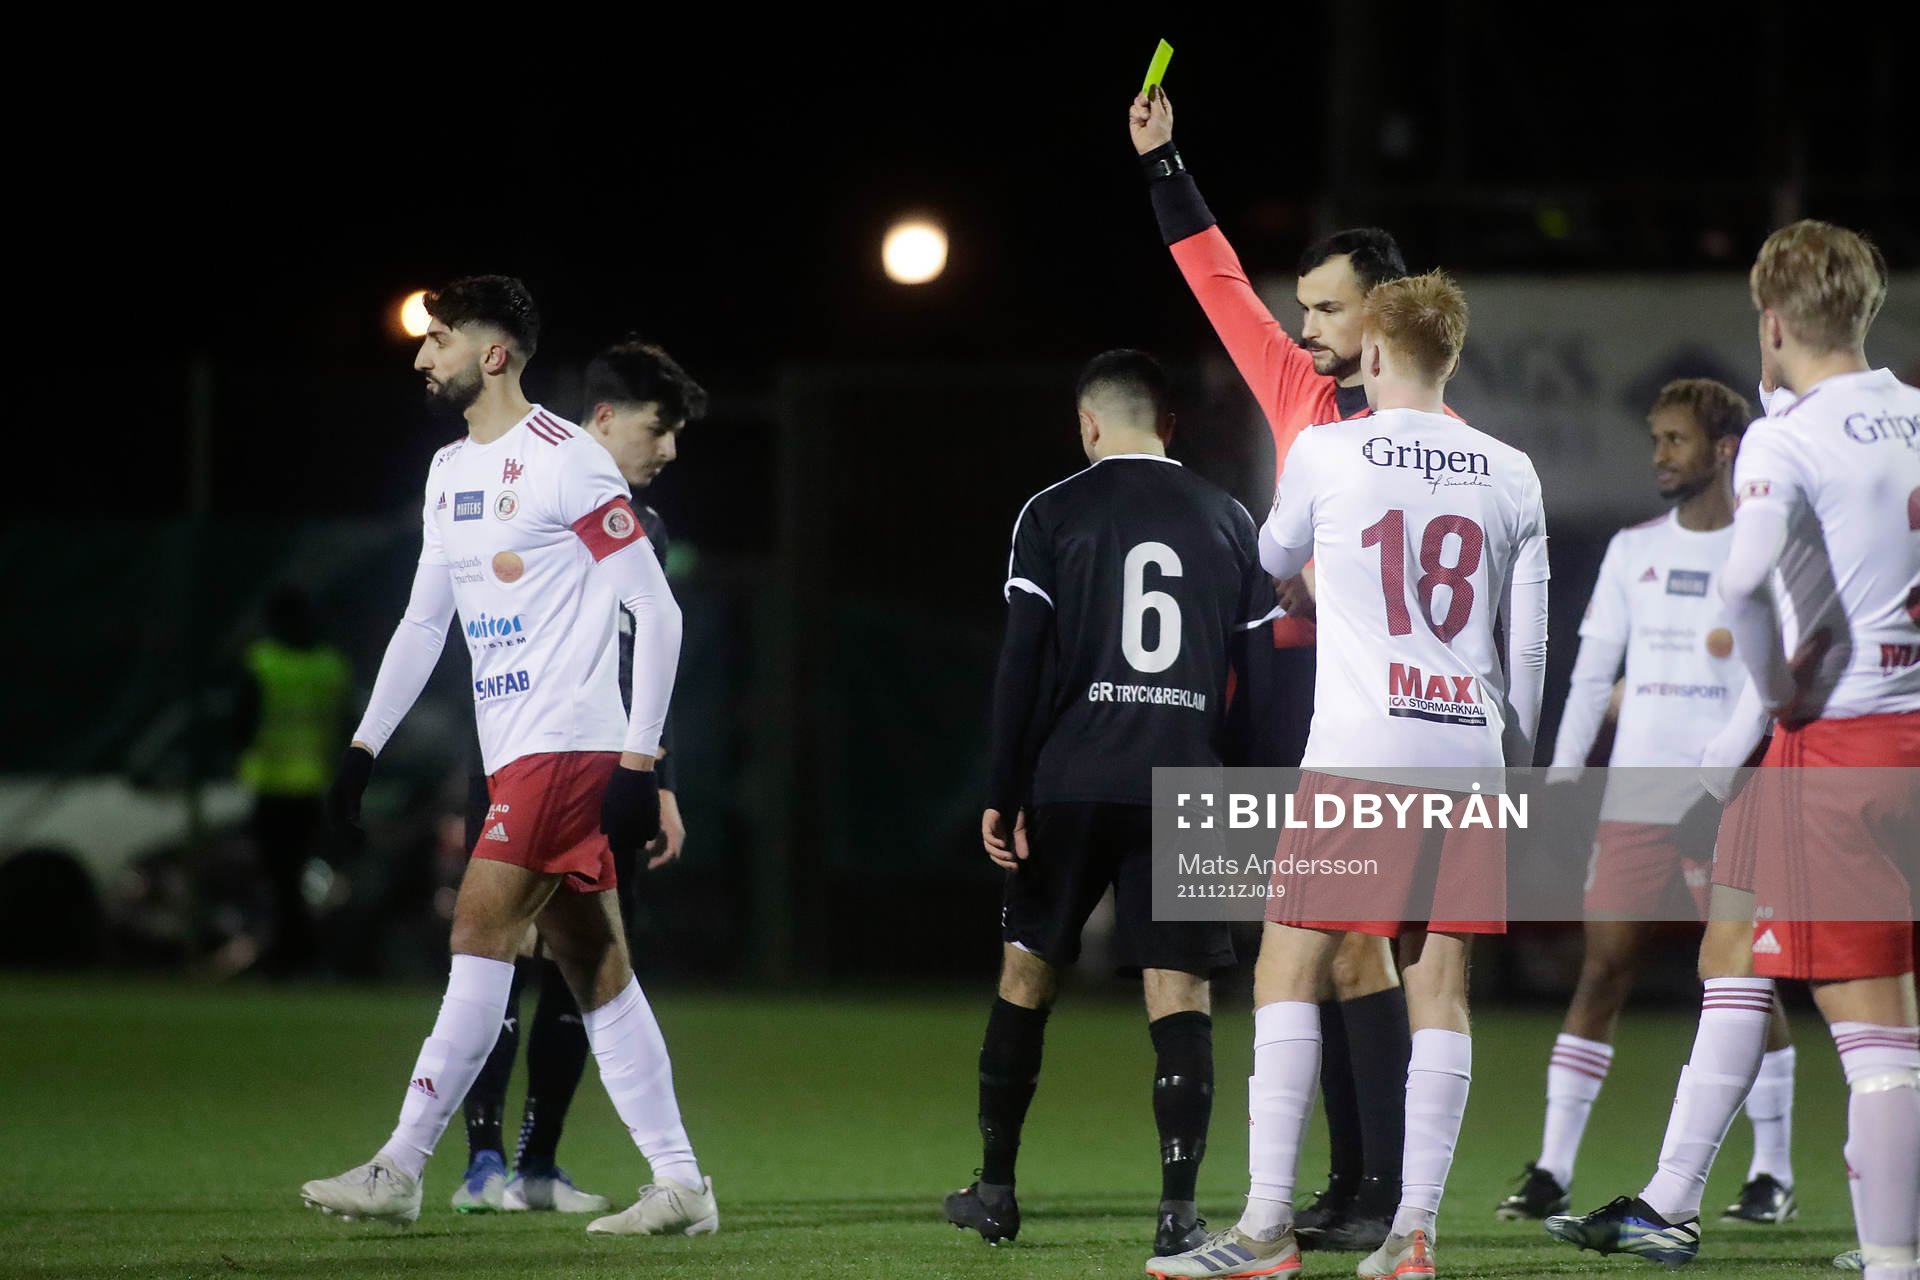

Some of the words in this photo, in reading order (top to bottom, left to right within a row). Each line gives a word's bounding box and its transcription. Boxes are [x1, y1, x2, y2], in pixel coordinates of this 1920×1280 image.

[1362, 437, 1491, 479] Gripen
[1444, 476, 1493, 488] Sweden
[1361, 509, 1484, 643] 18
[1121, 541, 1183, 673] 6
[1088, 681, 1114, 702] GR
[1115, 685, 1206, 712] TRYCK&REKLAM
[1389, 662, 1483, 704] MAXI
[1389, 697, 1406, 707] ICA
